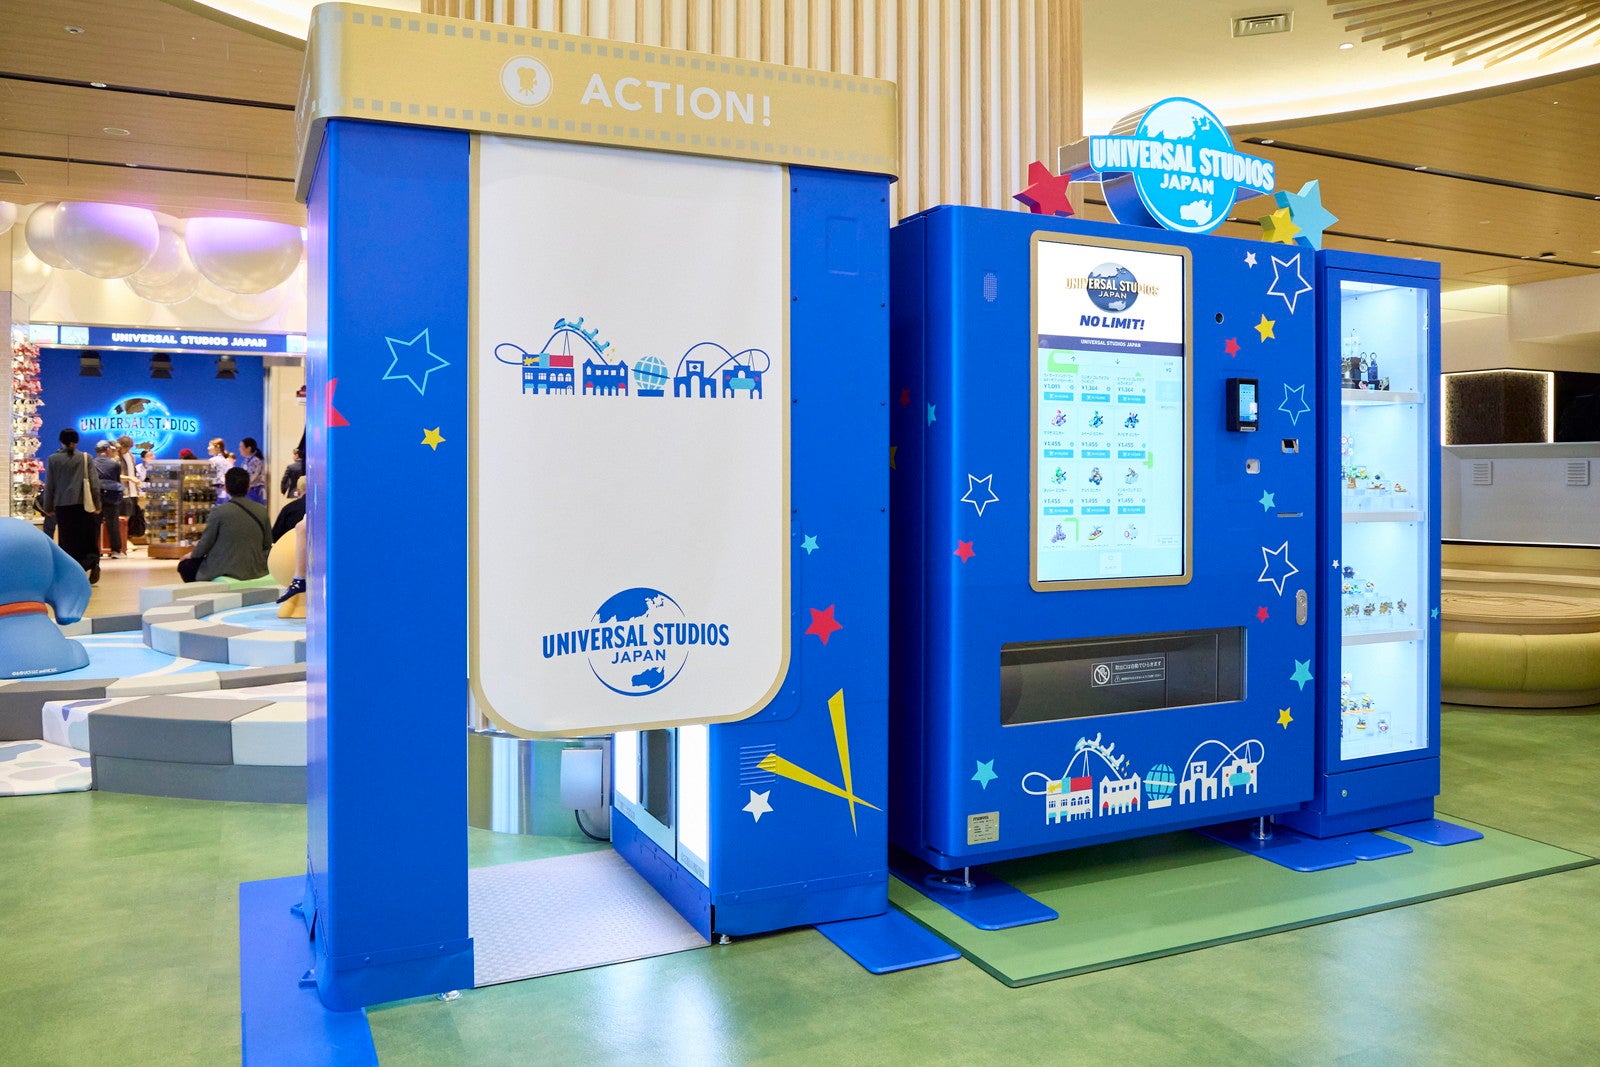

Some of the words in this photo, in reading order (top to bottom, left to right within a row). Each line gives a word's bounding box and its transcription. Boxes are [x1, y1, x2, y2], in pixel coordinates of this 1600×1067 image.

[580, 73, 771, 127] ACTION!
[1092, 138, 1196, 174] UNIVERSAL
[1200, 147, 1274, 191] STUDIOS
[1160, 173, 1215, 195] JAPAN
[1065, 277, 1118, 291] UNIVERSAL
[1120, 280, 1159, 297] STUDIOS
[1098, 291, 1127, 300] JAPAN
[1080, 315, 1100, 327] NO
[1102, 316, 1145, 331] LIMIT!
[111, 332, 177, 345] UNIVERSAL
[180, 335, 228, 347] STUDIOS
[231, 337, 267, 348] JAPAN
[80, 416, 145, 431] UNIVERSAL
[123, 430, 157, 438] JAPAN
[542, 624, 648, 659] UNIVERSAL
[653, 623, 730, 647] STUDIOS
[611, 649, 666, 665] JAPAN
